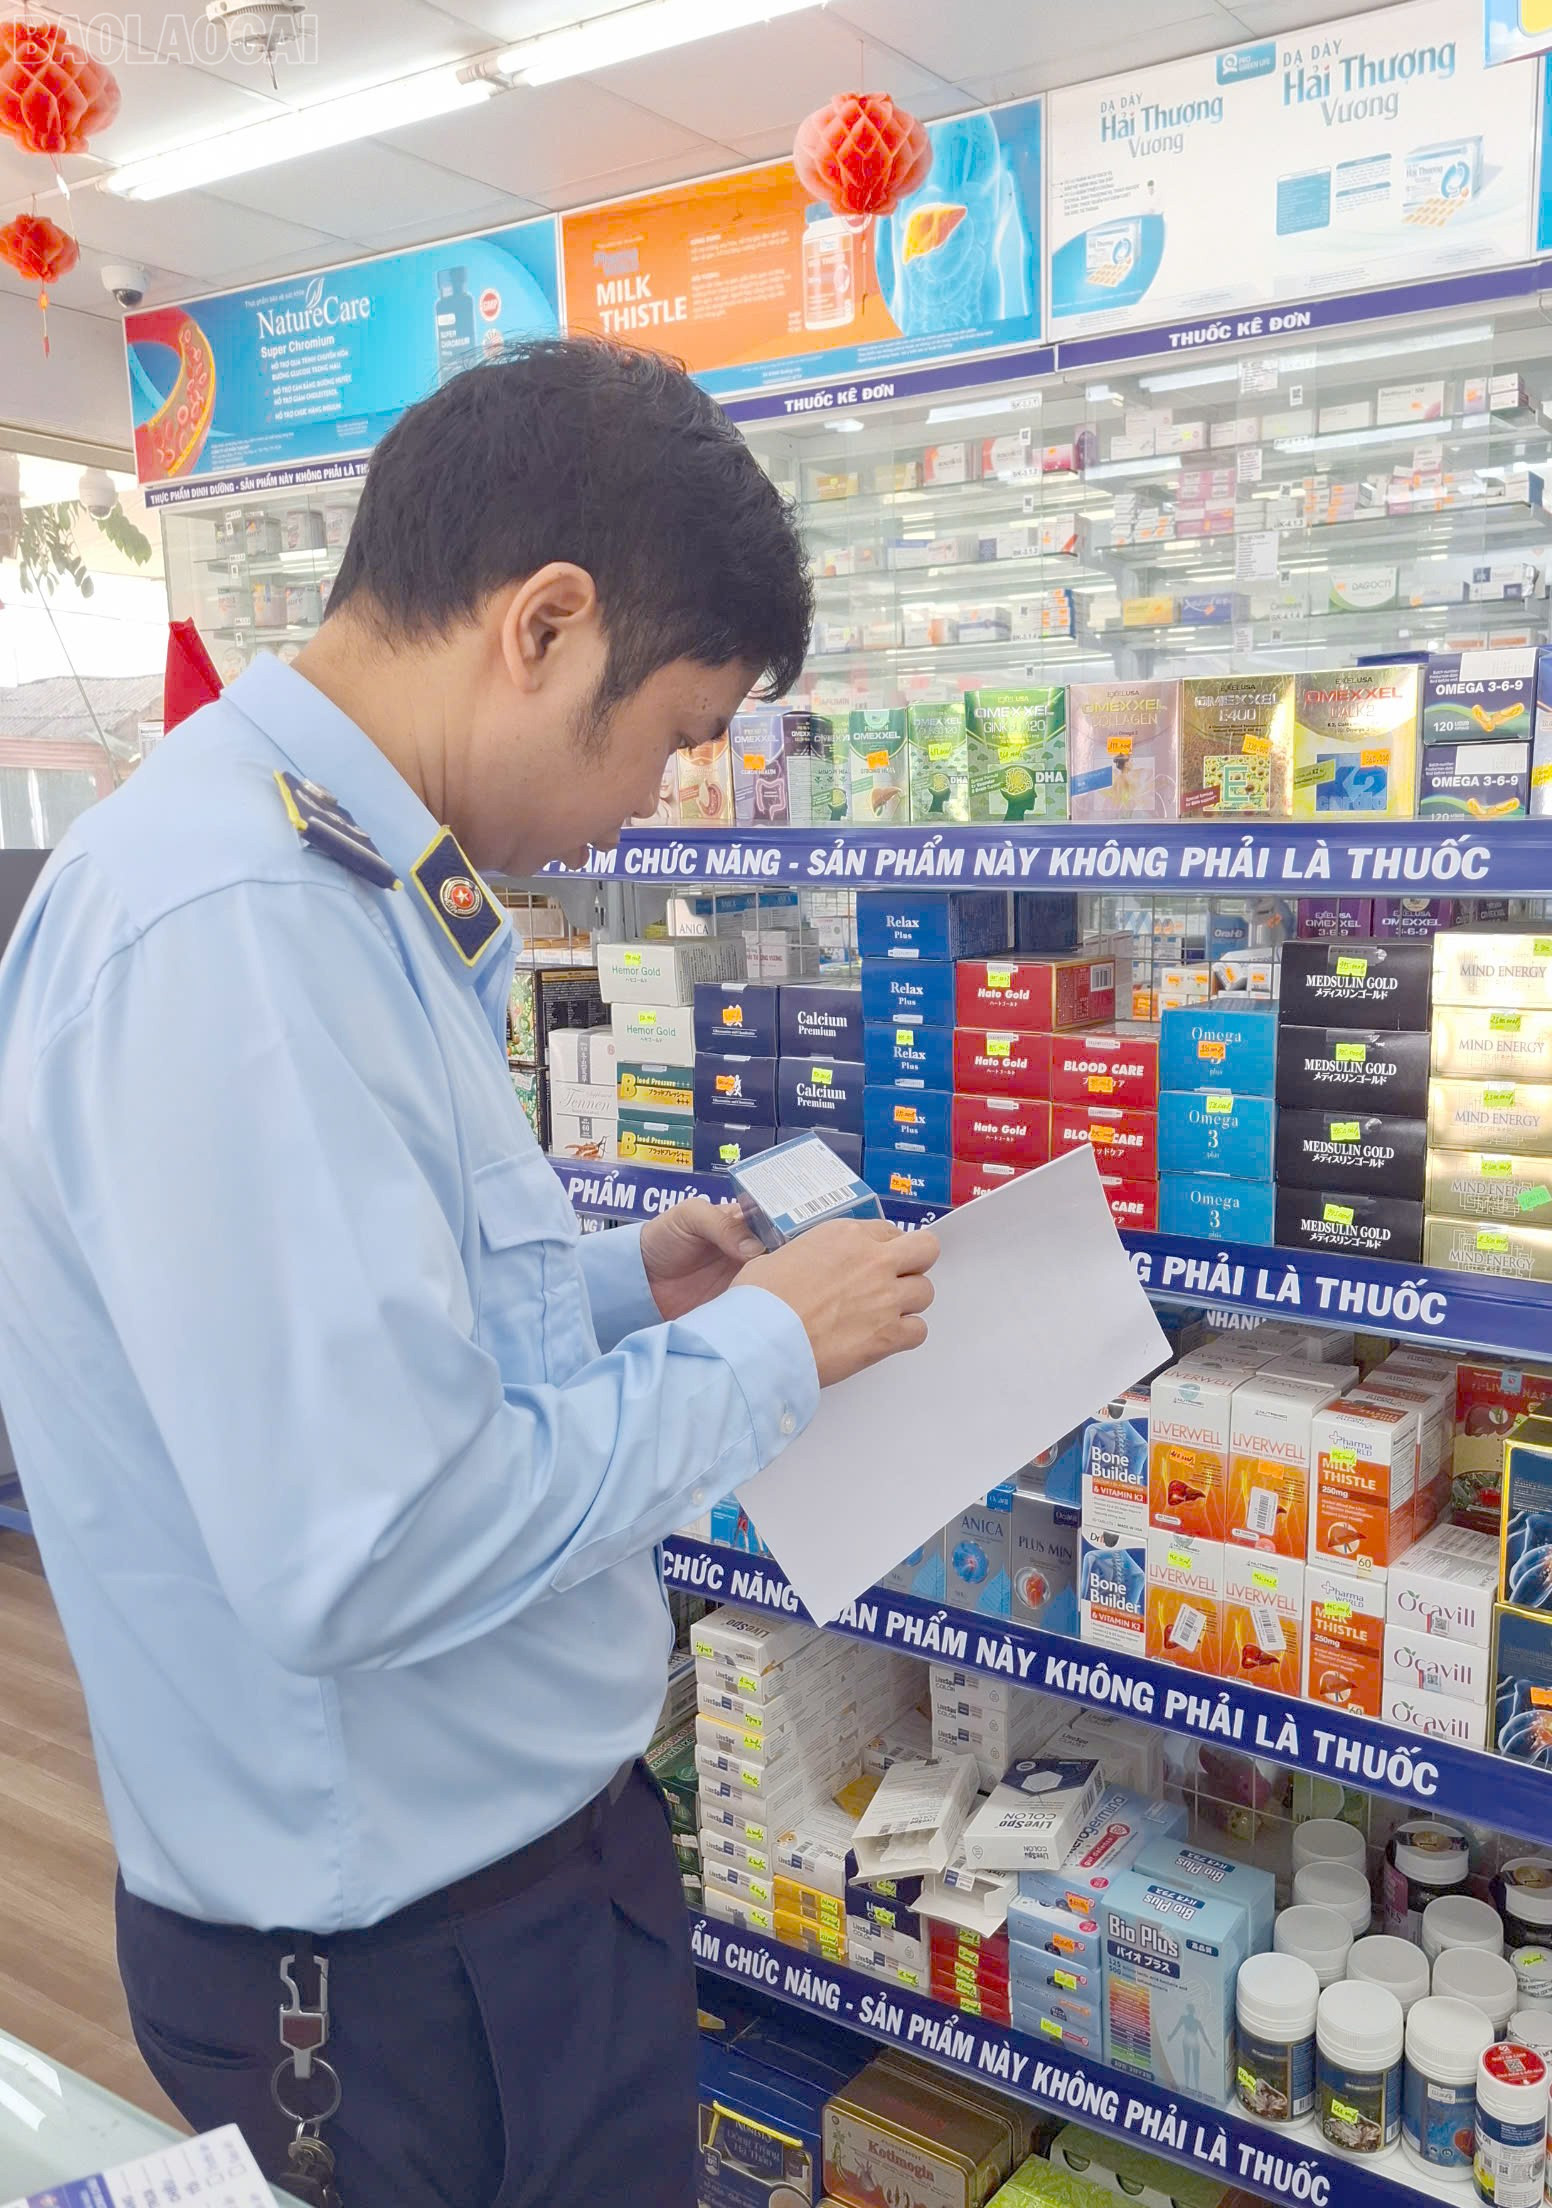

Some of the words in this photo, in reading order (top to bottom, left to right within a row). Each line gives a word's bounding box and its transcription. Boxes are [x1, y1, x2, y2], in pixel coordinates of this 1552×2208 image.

[1283, 64, 1330, 106] Hải
[1339, 41, 1456, 92] Thượng
[1320, 91, 1399, 127] Vương
[1101, 112, 1135, 143] Hải
[1141, 95, 1223, 132] Thượng
[1128, 133, 1184, 159] Vương
[596, 274, 651, 306] MILK
[257, 295, 370, 339] NatureCare
[599, 296, 687, 334] THISTLE
[1169, 321, 1231, 347] THUỐC
[1237, 316, 1262, 337] KÊ
[1269, 312, 1310, 331] ĐƠN
[261, 345, 286, 358] Super
[288, 335, 335, 352] Chromium
[784, 389, 833, 412] THUỐC
[837, 387, 857, 405] KÊ
[862, 383, 894, 401] ĐƠN
[151, 492, 169, 504] THỰC
[170, 488, 190, 502] PHẨM
[191, 488, 208, 499] DINH
[209, 482, 235, 496] DƯỠNG
[240, 477, 255, 491] SẢN
[256, 475, 277, 489] PHẨM
[279, 472, 294, 485] NÀY
[295, 468, 322, 483] KHÔNG
[323, 463, 342, 480] PHẢI
[344, 462, 355, 476] LÀ
[1435, 683, 1484, 696] OMEGA
[1488, 679, 1523, 693] 3-6-9
[853, 731, 901, 741] OMEXXEL
[1433, 721, 1454, 732] 120
[734, 733, 779, 743] OMEXXEL
[1036, 770, 1065, 783] DHA
[1223, 765, 1249, 803] E
[1431, 776, 1480, 788] OMEGA
[1483, 774, 1519, 786] 3-6-9
[624, 841, 698, 876] CHỨC
[705, 842, 781, 877] NĂNG
[806, 838, 867, 877] SẢN
[874, 833, 965, 877] PHẨM
[973, 838, 1039, 877] NÀY
[1047, 839, 1168, 878] KHÔNG
[1179, 834, 1270, 878] PHẢI
[1280, 838, 1331, 879] LÀ
[1346, 833, 1491, 880] THUỐC
[679, 923, 709, 935] ANICA
[886, 915, 920, 929] Relax
[894, 930, 912, 940] Plus
[612, 965, 640, 976] Hemor
[641, 966, 661, 977] Gold
[1460, 964, 1494, 977] MIND
[1499, 965, 1548, 978] ENERGY
[890, 981, 924, 996] Relax
[1306, 974, 1365, 989] MEDSULIN
[1367, 976, 1398, 990] GOLD
[898, 996, 916, 1006] Plus
[977, 987, 1002, 999] Hato
[1005, 989, 1030, 1001] Gold
[1314, 989, 1388, 1000] メディスリンゴールド
[797, 1010, 848, 1028] Calcium
[626, 1025, 654, 1036] Hemor
[656, 1026, 676, 1037] Gold
[798, 1026, 837, 1037] Premium
[1191, 1026, 1242, 1046] Omega
[893, 1046, 926, 1060] Relax
[1459, 1039, 1493, 1051] MIND
[1497, 1040, 1545, 1053] ENERGY
[974, 1055, 999, 1067] Hato
[1002, 1057, 1028, 1069] Gold
[1063, 1060, 1107, 1074] BLOOD
[1111, 1064, 1144, 1077] CARE
[1304, 1058, 1364, 1074] MEDSULIN
[1365, 1062, 1397, 1076] GOLD
[796, 1082, 847, 1100] Calcium
[797, 1097, 836, 1110] Premium
[1188, 1109, 1239, 1129] Omega
[1455, 1111, 1489, 1123] MIND
[1493, 1114, 1540, 1127] ENERGY
[1207, 1129, 1219, 1149] 3
[1303, 1140, 1362, 1157] MEDSULIN
[1364, 1145, 1395, 1159] GOLD
[1112, 1201, 1144, 1215] CARE
[1190, 1190, 1240, 1209] Omega
[1209, 1209, 1220, 1228] 3
[1163, 1252, 1244, 1296] PHẢI
[1255, 1264, 1300, 1305] LÀ
[1315, 1278, 1448, 1326] THUỐC
[1164, 1370, 1234, 1387] LIVERWELL
[1153, 1420, 1223, 1446] LIVERWELL
[1091, 1446, 1129, 1466] Bone
[1232, 1433, 1306, 1460] LIVERWELL
[1091, 1462, 1145, 1486] Builder
[1322, 1457, 1356, 1474] MILK
[1322, 1470, 1377, 1491] THISTLE
[1101, 1487, 1133, 1500] VITAMIN
[1134, 1494, 1144, 1502] K2
[1321, 1485, 1349, 1499] 250mg
[961, 1515, 1004, 1537] ANICA
[1018, 1535, 1045, 1553] PLUS
[1048, 1543, 1073, 1560] MIN
[1357, 1557, 1372, 1569] 60
[1090, 1573, 1127, 1595] Bone
[1090, 1589, 1141, 1614] Builder
[1397, 1592, 1475, 1628] Ocavill
[725, 1618, 771, 1639] LiveSpo
[1315, 1619, 1368, 1642] THISTLE
[1313, 1633, 1340, 1648] 250mg
[662, 1547, 724, 1590] CHỨC
[731, 1563, 801, 1613] NĂNG
[885, 1609, 967, 1658] PHẨM
[975, 1636, 1037, 1682] NÀY
[1045, 1654, 1155, 1715] KHÔNG
[1164, 1692, 1244, 1740] PHẢI
[1255, 1712, 1300, 1756] LÀ
[1313, 1729, 1439, 1796] THUỐC
[1393, 1648, 1472, 1685] Ocavill
[1391, 1703, 1469, 1739] Ocavill
[1175, 1857, 1204, 1874] Plus
[1203, 1866, 1225, 1882] Bio
[1143, 1894, 1173, 1914] Plus
[1174, 1904, 1195, 1921] Bio
[1107, 1913, 1136, 1943] Bio
[1140, 1924, 1179, 1959] Plus
[725, 1941, 780, 1985] CHỨC
[784, 1965, 841, 2011] NĂNG
[858, 1991, 902, 2035] SẢN
[908, 2014, 976, 2064] PHẨM
[978, 2039, 1029, 2083] NÀY
[1031, 2063, 1119, 2122] KHÔNG
[1124, 2103, 1188, 2151] PHẢI
[1193, 2126, 1228, 2168] LÀ
[1238, 2142, 1331, 2207] THUỐC
